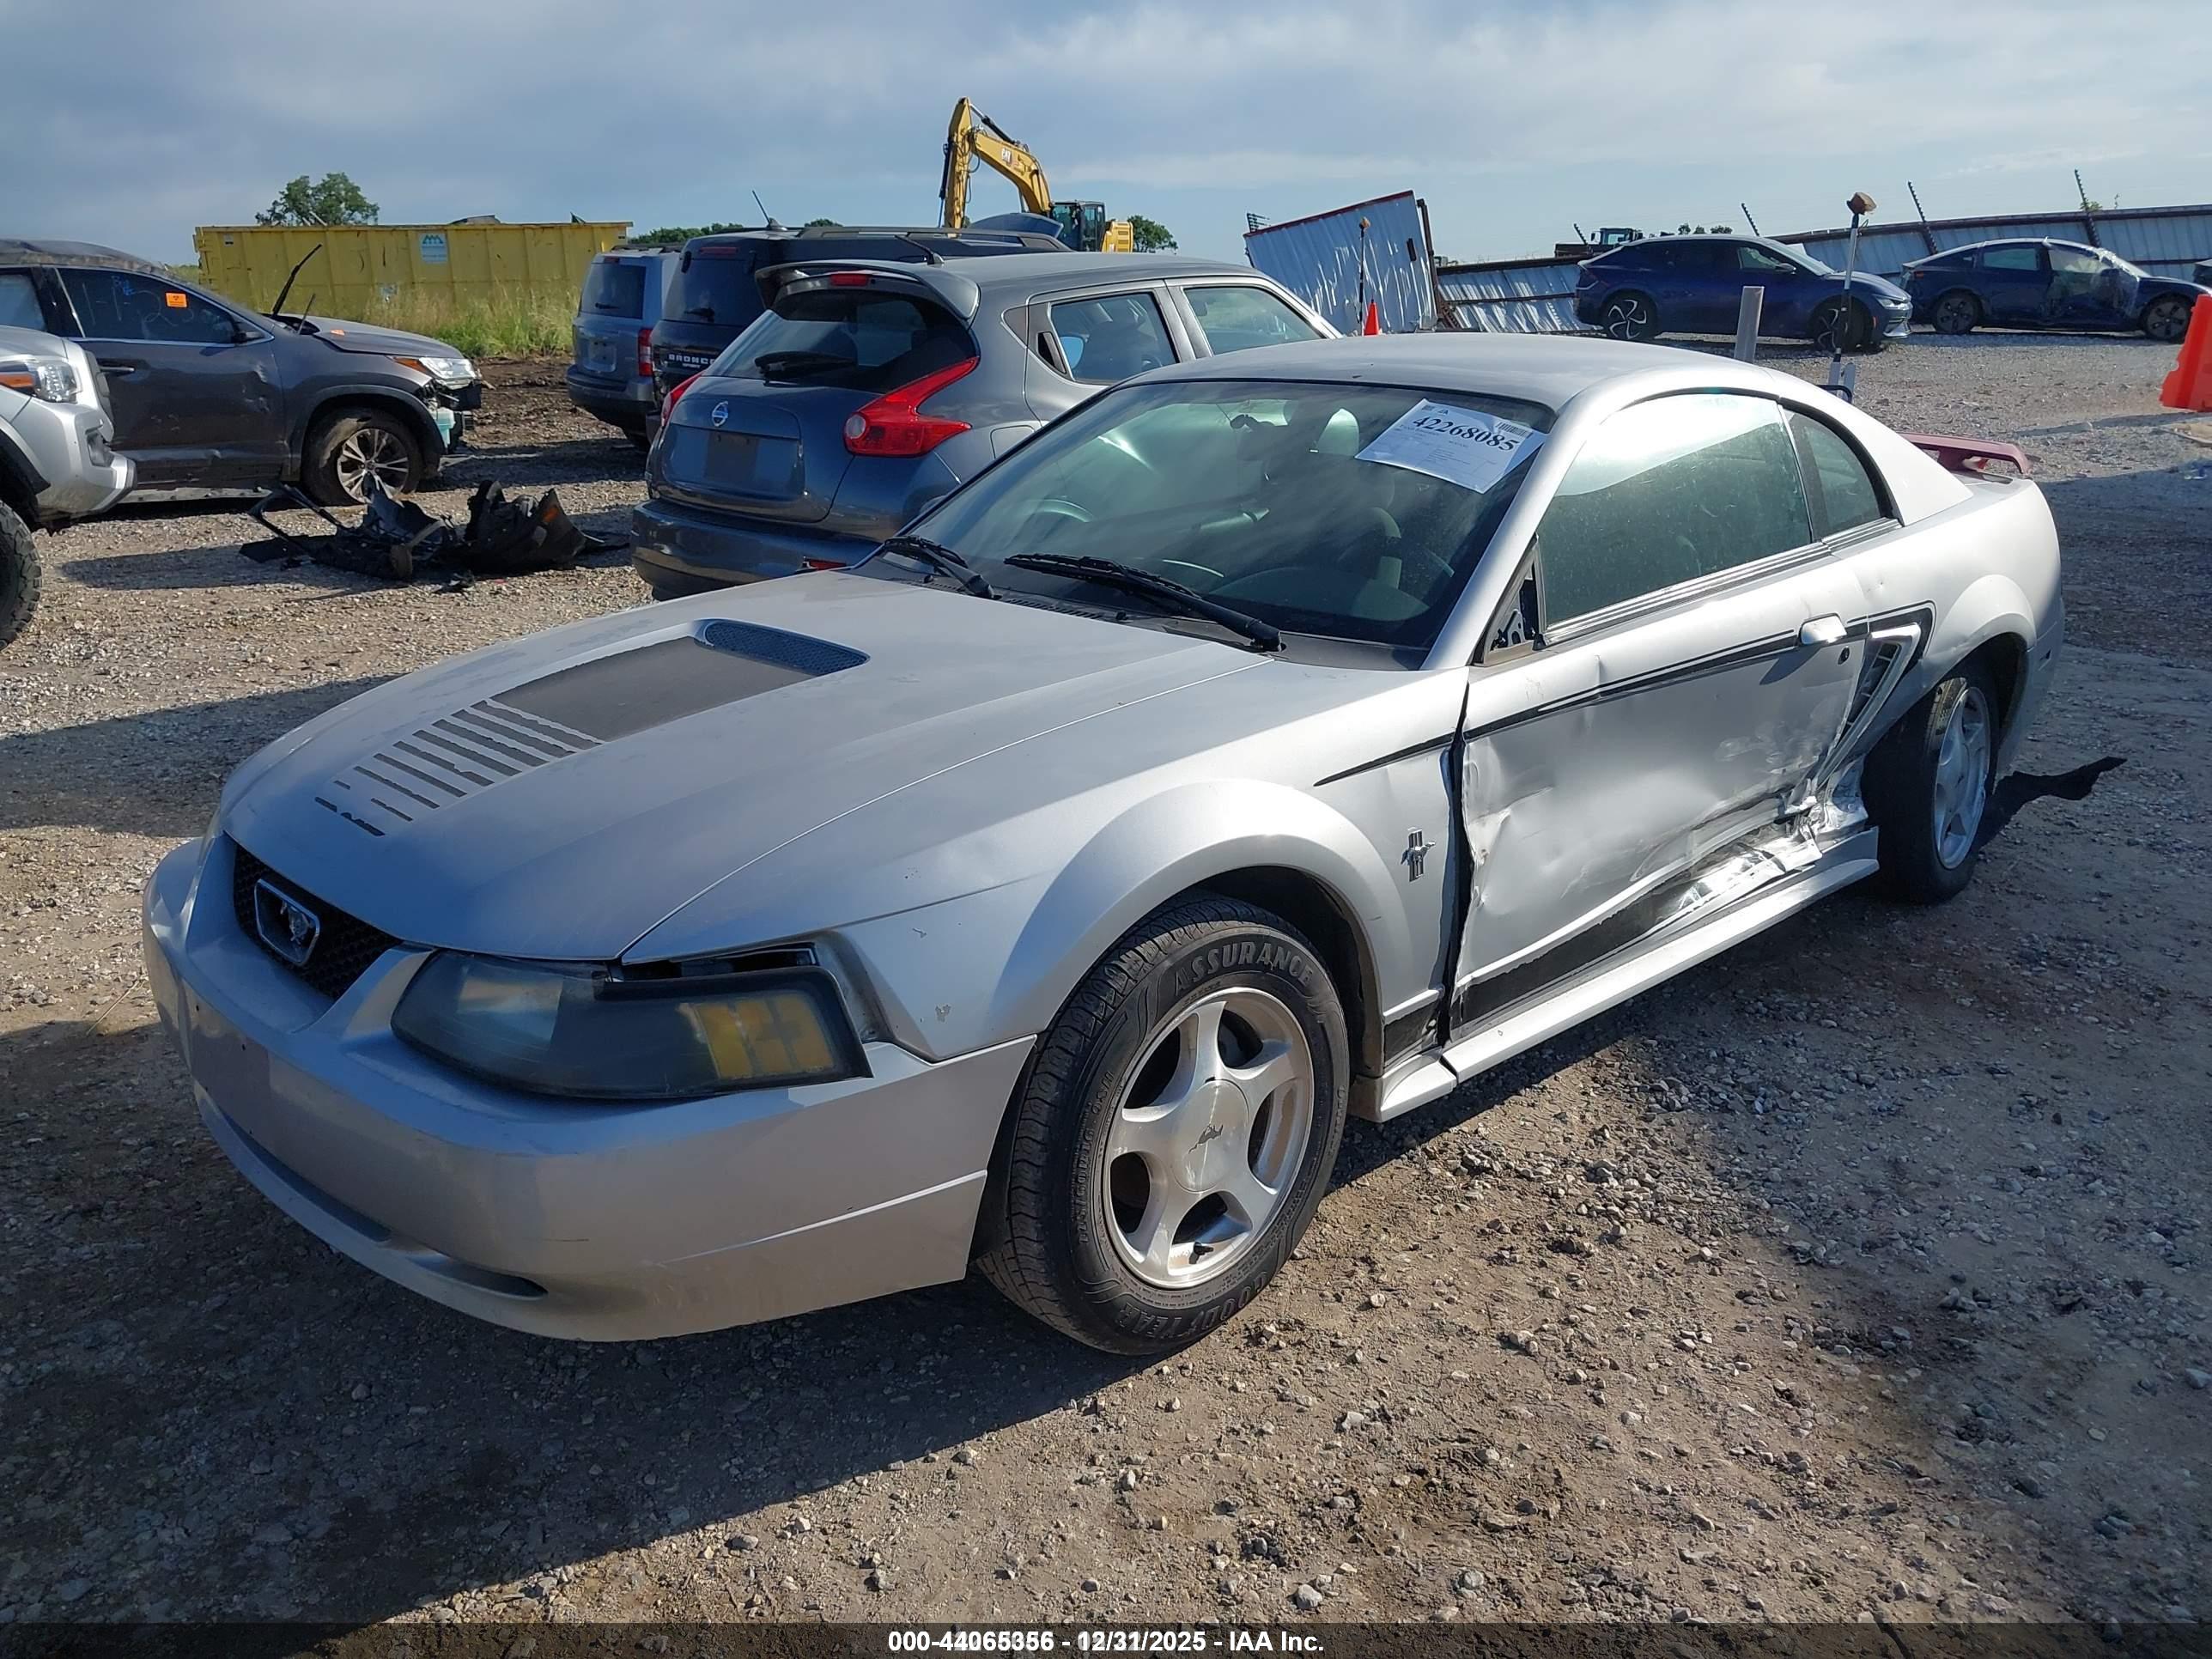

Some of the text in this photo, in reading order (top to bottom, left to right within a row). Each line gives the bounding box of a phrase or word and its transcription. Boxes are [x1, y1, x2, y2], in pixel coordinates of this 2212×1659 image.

[1001, 148, 1011, 162] CAT
[1413, 416, 1520, 451] 42268085
[1175, 941, 1313, 996] ASSURANCE
